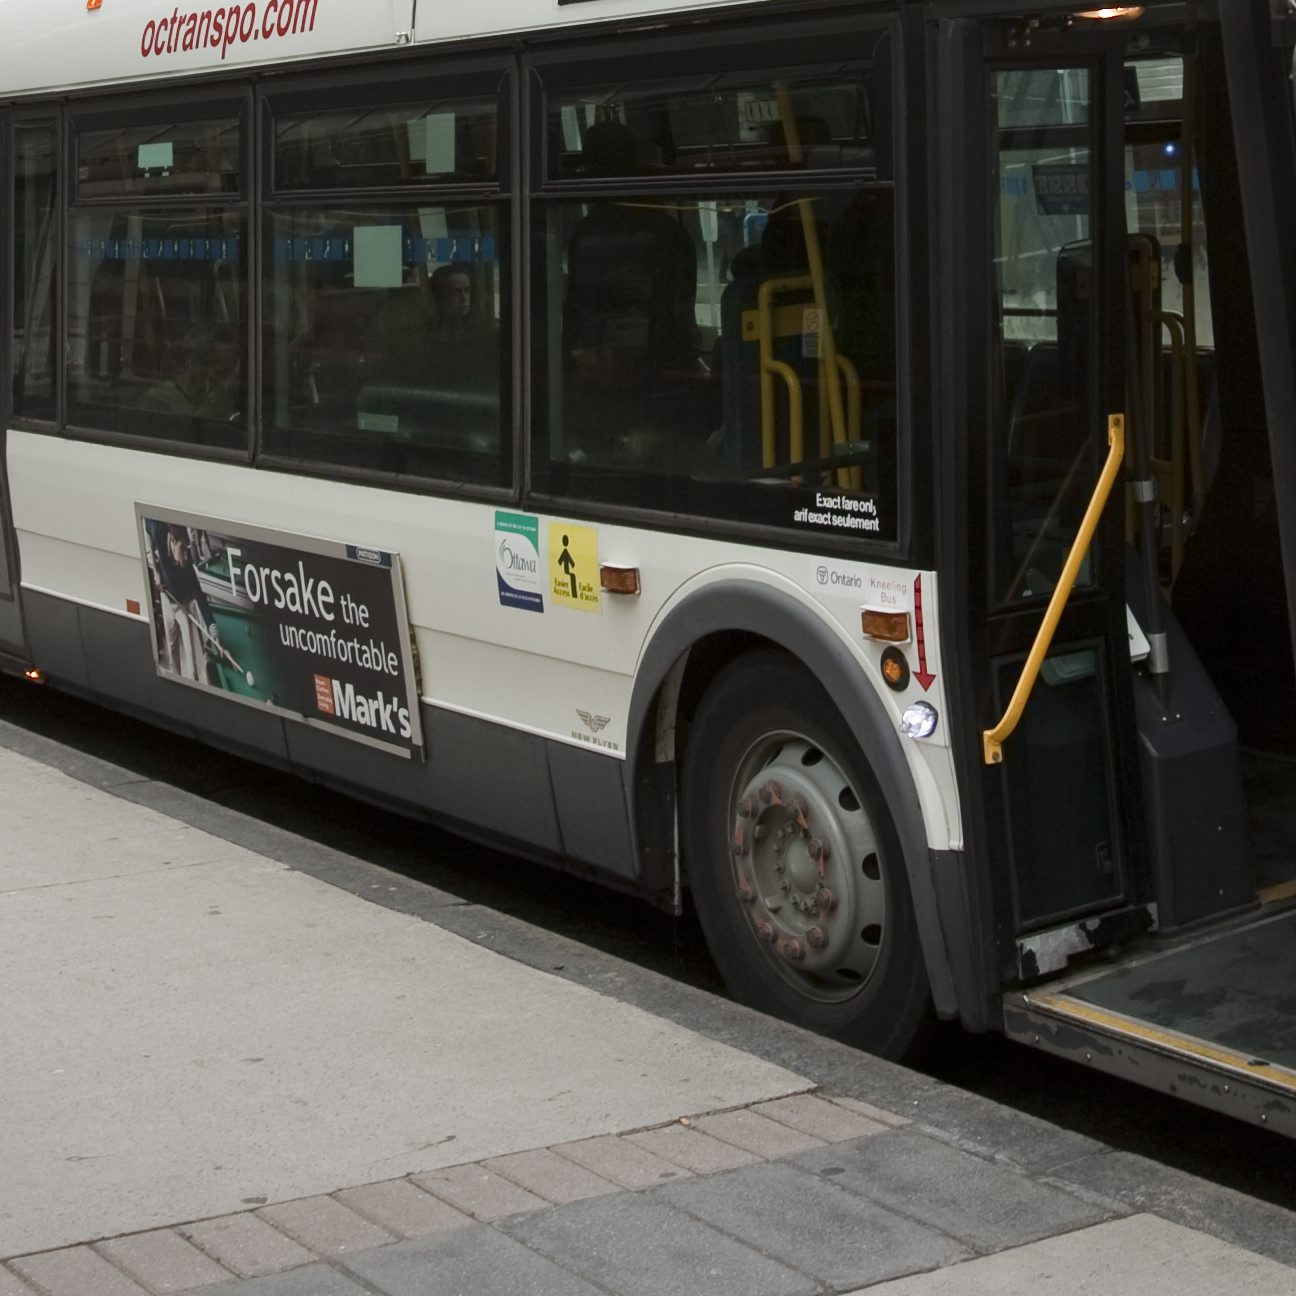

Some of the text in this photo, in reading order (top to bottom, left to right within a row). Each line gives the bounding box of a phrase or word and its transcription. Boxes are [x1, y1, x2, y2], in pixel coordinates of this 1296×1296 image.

[816, 492, 841, 510] Exact
[842, 496, 859, 512] fare
[808, 511, 831, 526] exact
[832, 514, 880, 532] seulement
[226, 547, 370, 628] Forsake the
[831, 571, 862, 588] Ontario
[870, 578, 907, 595] Kneeling
[880, 591, 897, 604] Bus
[279, 623, 399, 676] uncomfortable
[331, 679, 413, 739] Mark's
